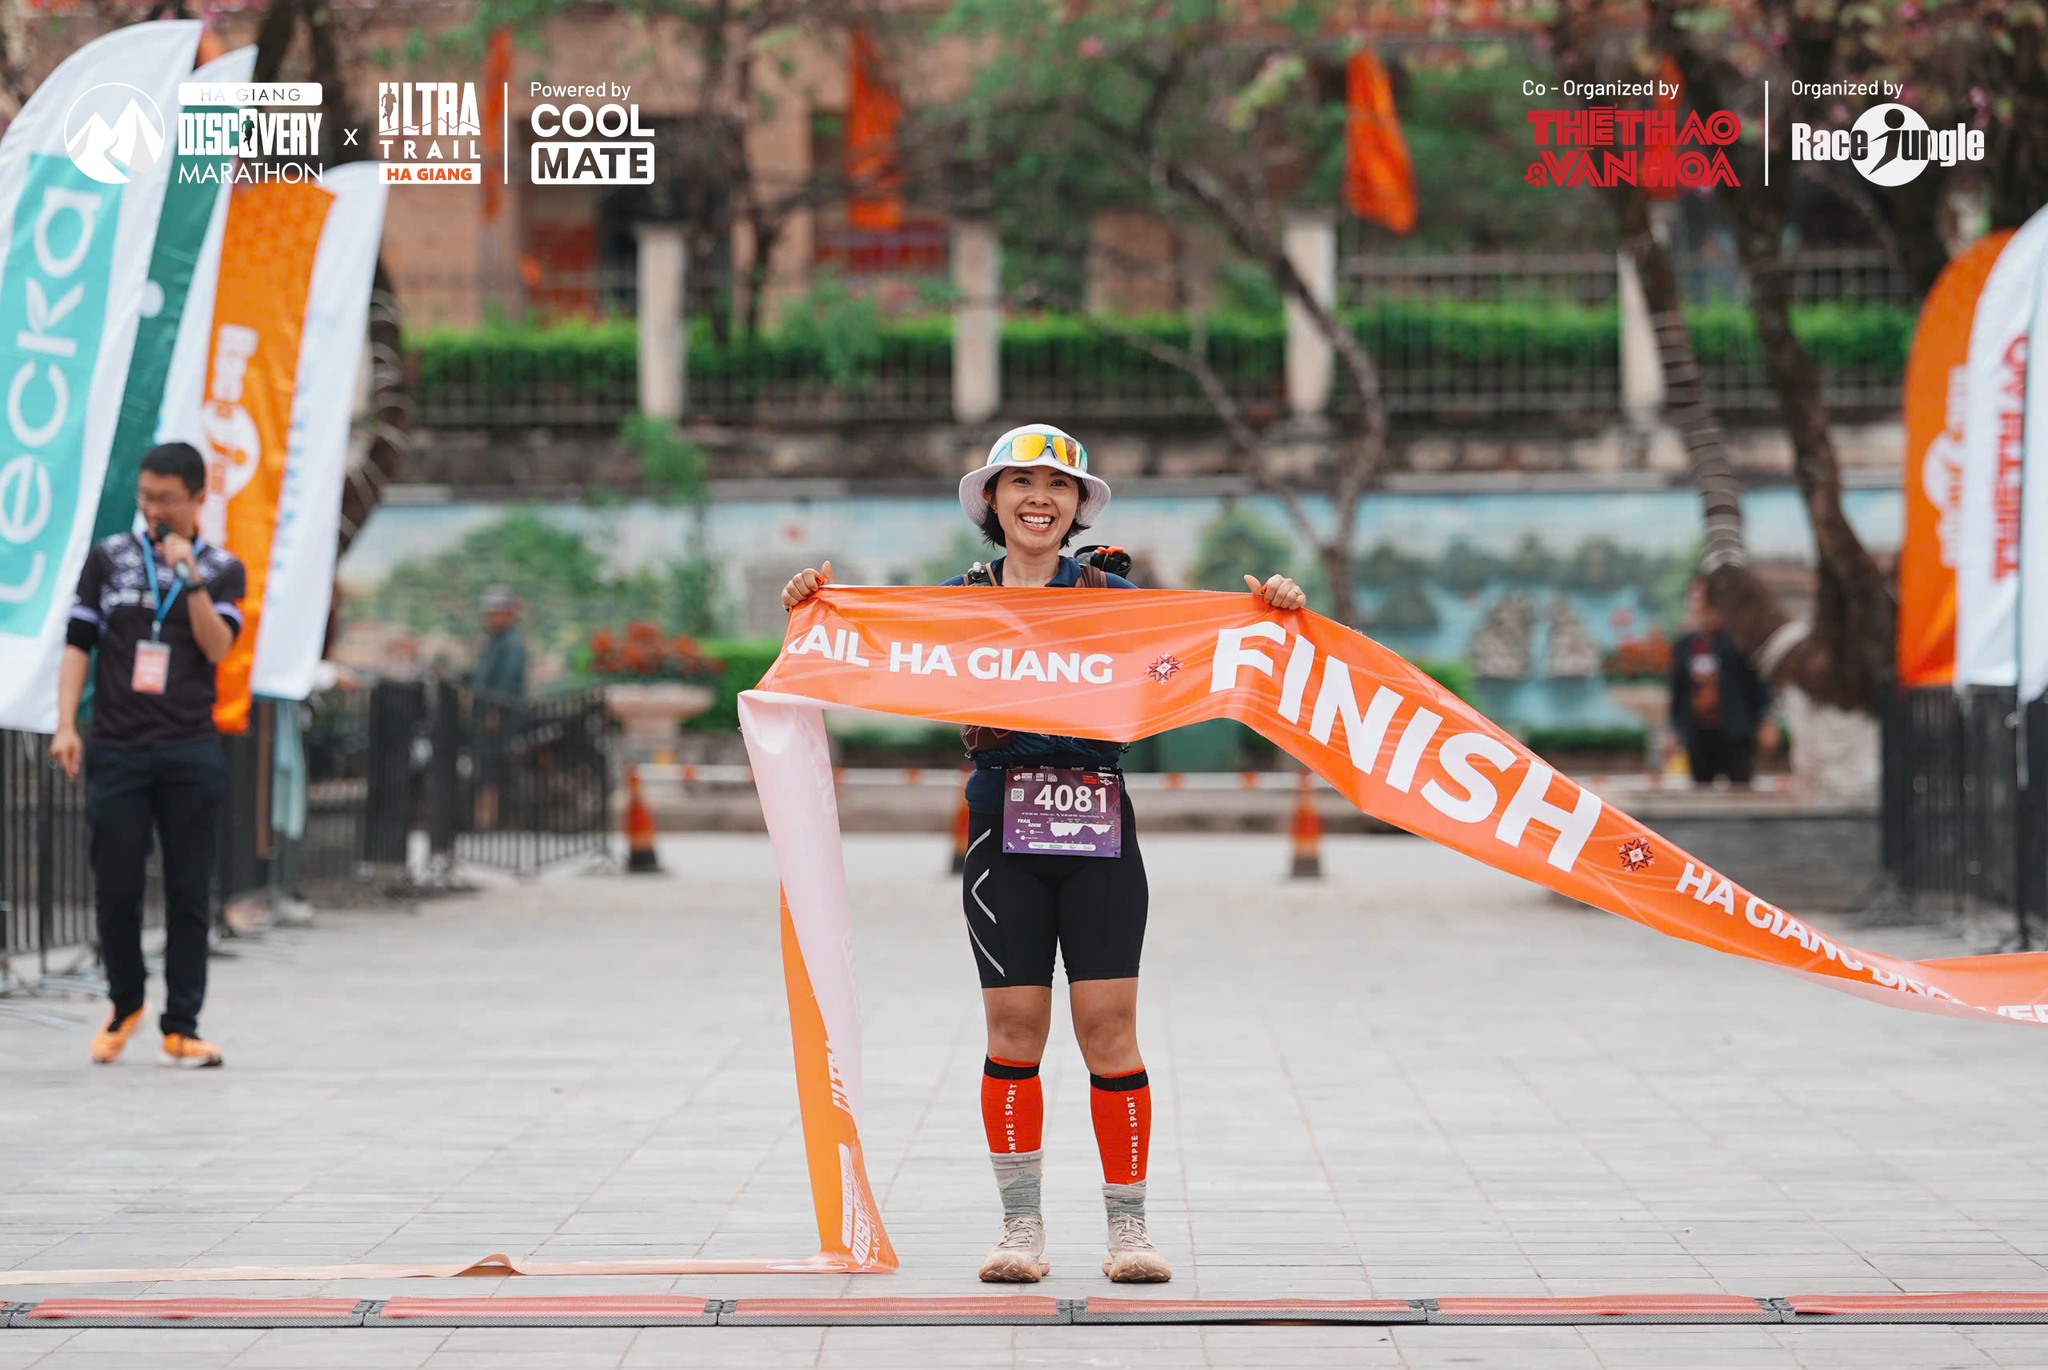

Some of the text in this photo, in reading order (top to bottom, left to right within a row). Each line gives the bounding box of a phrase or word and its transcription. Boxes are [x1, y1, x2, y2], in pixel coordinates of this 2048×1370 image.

[786, 624, 1113, 685] AIL HA GIANG
[1210, 621, 1602, 873] FINISH
[1034, 784, 1107, 813] 4081
[1675, 862, 1734, 916] HA
